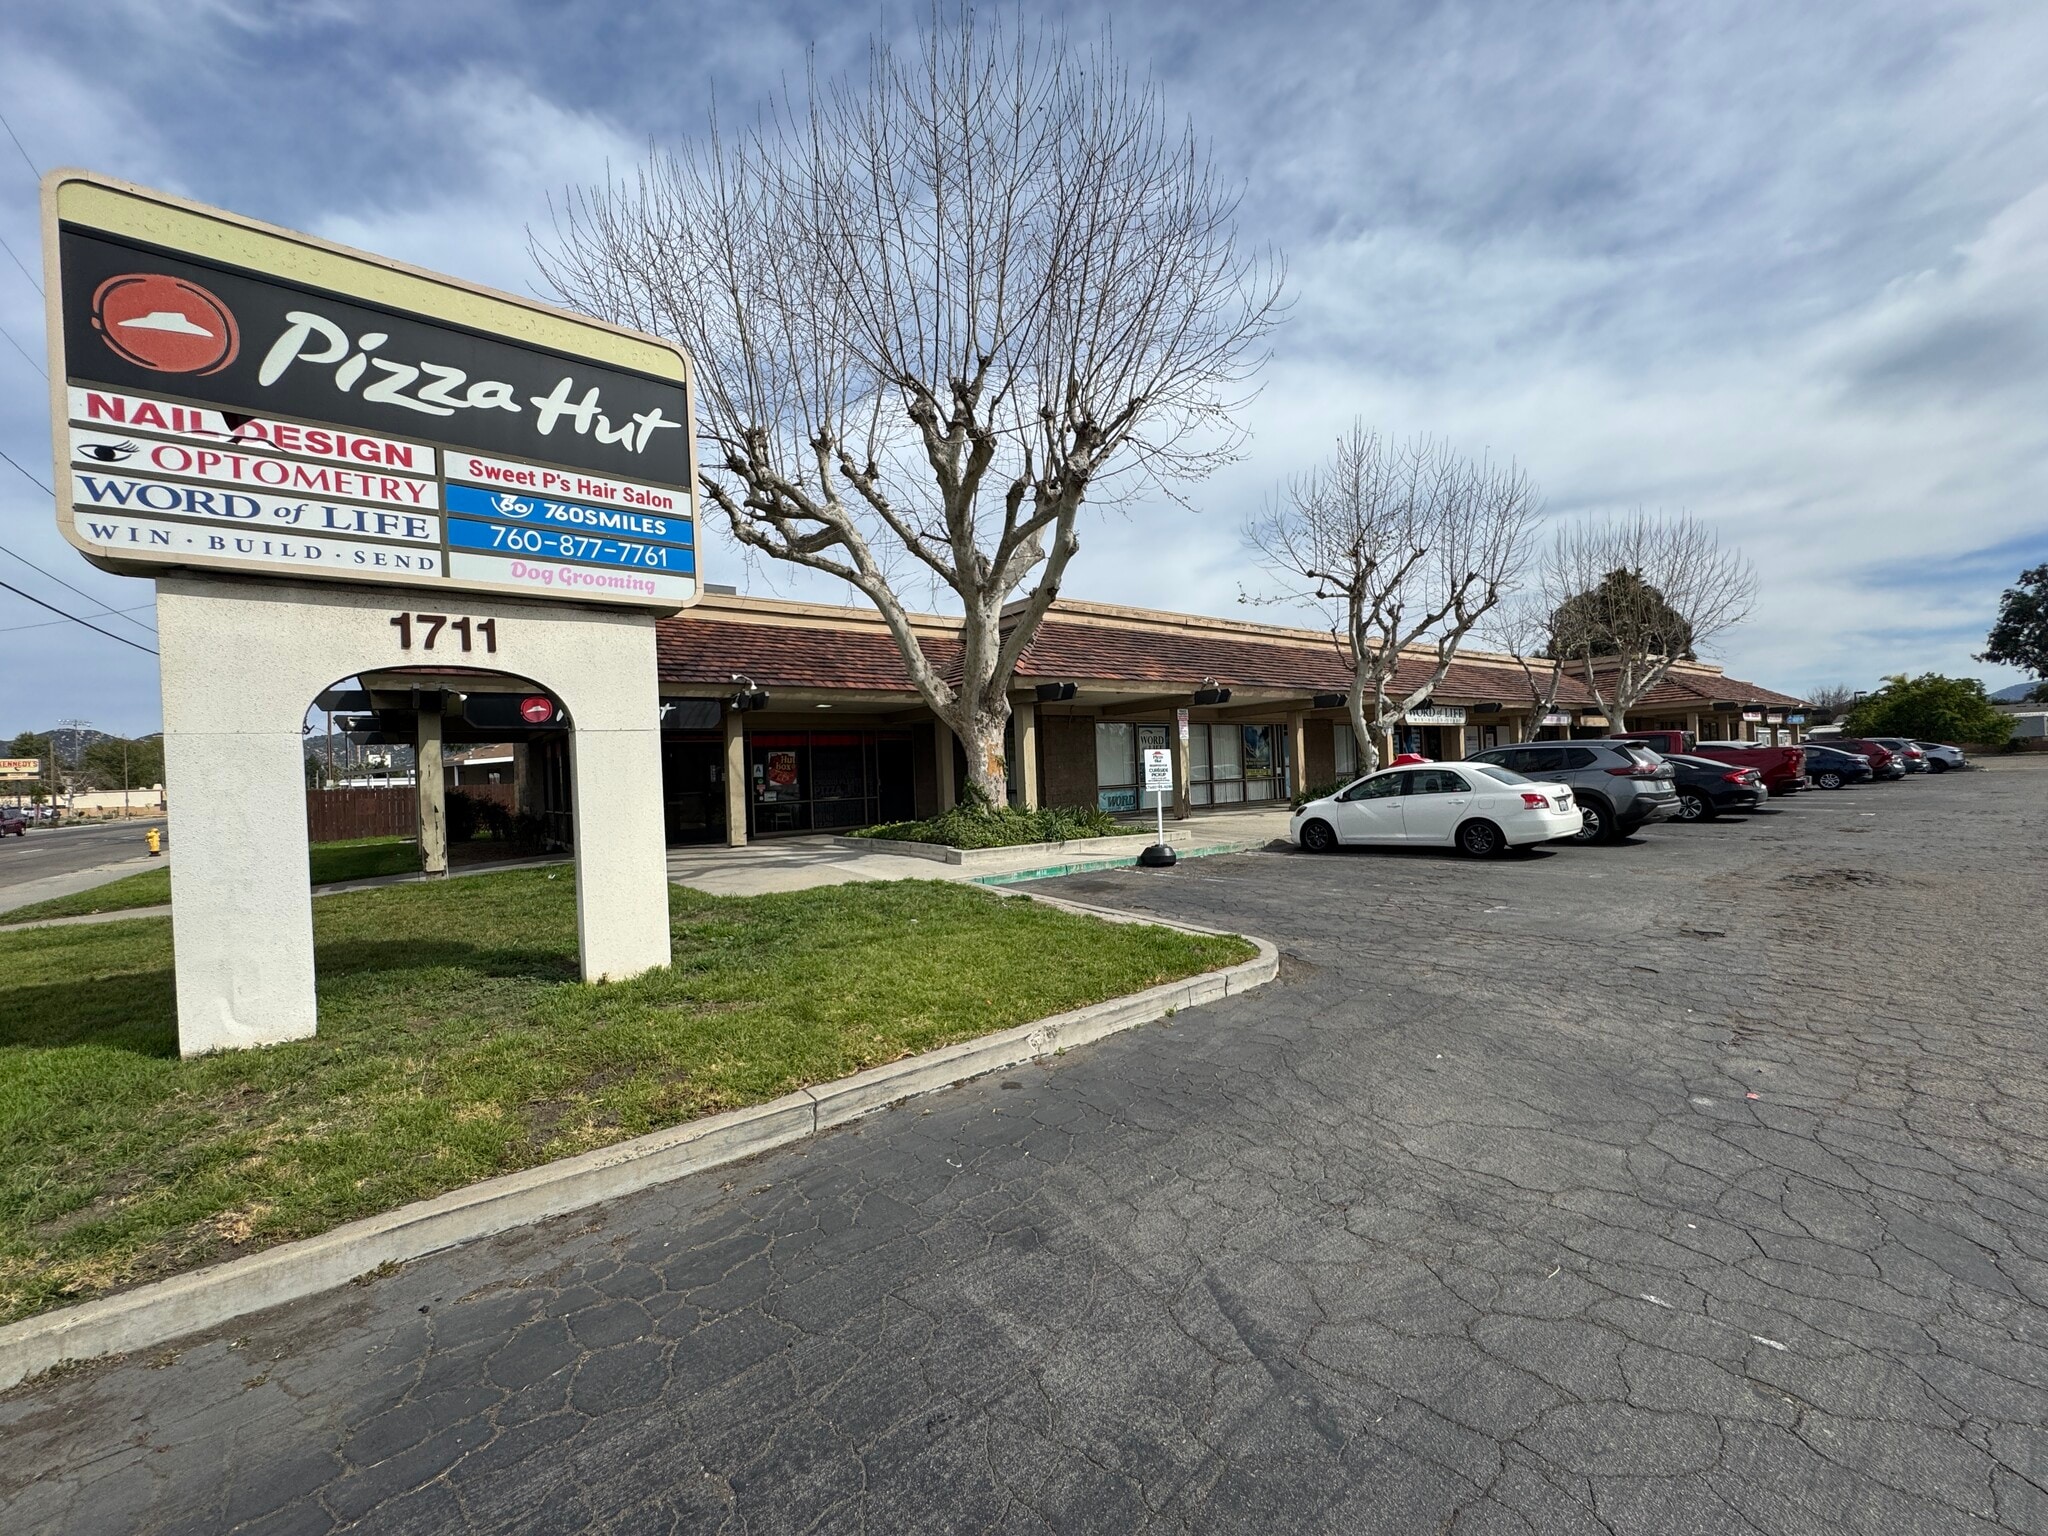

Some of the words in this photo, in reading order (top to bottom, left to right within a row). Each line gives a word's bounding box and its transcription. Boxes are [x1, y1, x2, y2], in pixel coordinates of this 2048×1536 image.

[258, 310, 522, 416] Pizza
[530, 376, 682, 454] Hut
[86, 392, 220, 438] NAIL
[233, 420, 413, 469] DESIGN
[150, 445, 427, 503] OPTOMETRY
[469, 459, 536, 487] Sweet
[543, 472, 571, 492] P's
[577, 478, 617, 500] Hair
[623, 486, 673, 510] Salon
[75, 475, 261, 519] WORD
[274, 503, 309, 525] of
[321, 506, 430, 540] LIFE
[543, 502, 667, 536] 760SMILES
[87, 522, 172, 546] WIN
[208, 535, 323, 560] BUILD
[354, 550, 434, 571] SEND
[490, 525, 668, 567] 760-877-7761
[510, 560, 554, 585] Dog
[558, 567, 656, 595] Grooming
[390, 612, 497, 654] 1711
[1445, 708, 1464, 718] LIFE
[1140, 735, 1165, 745] WORD
[1107, 796, 1136, 807] WORD
